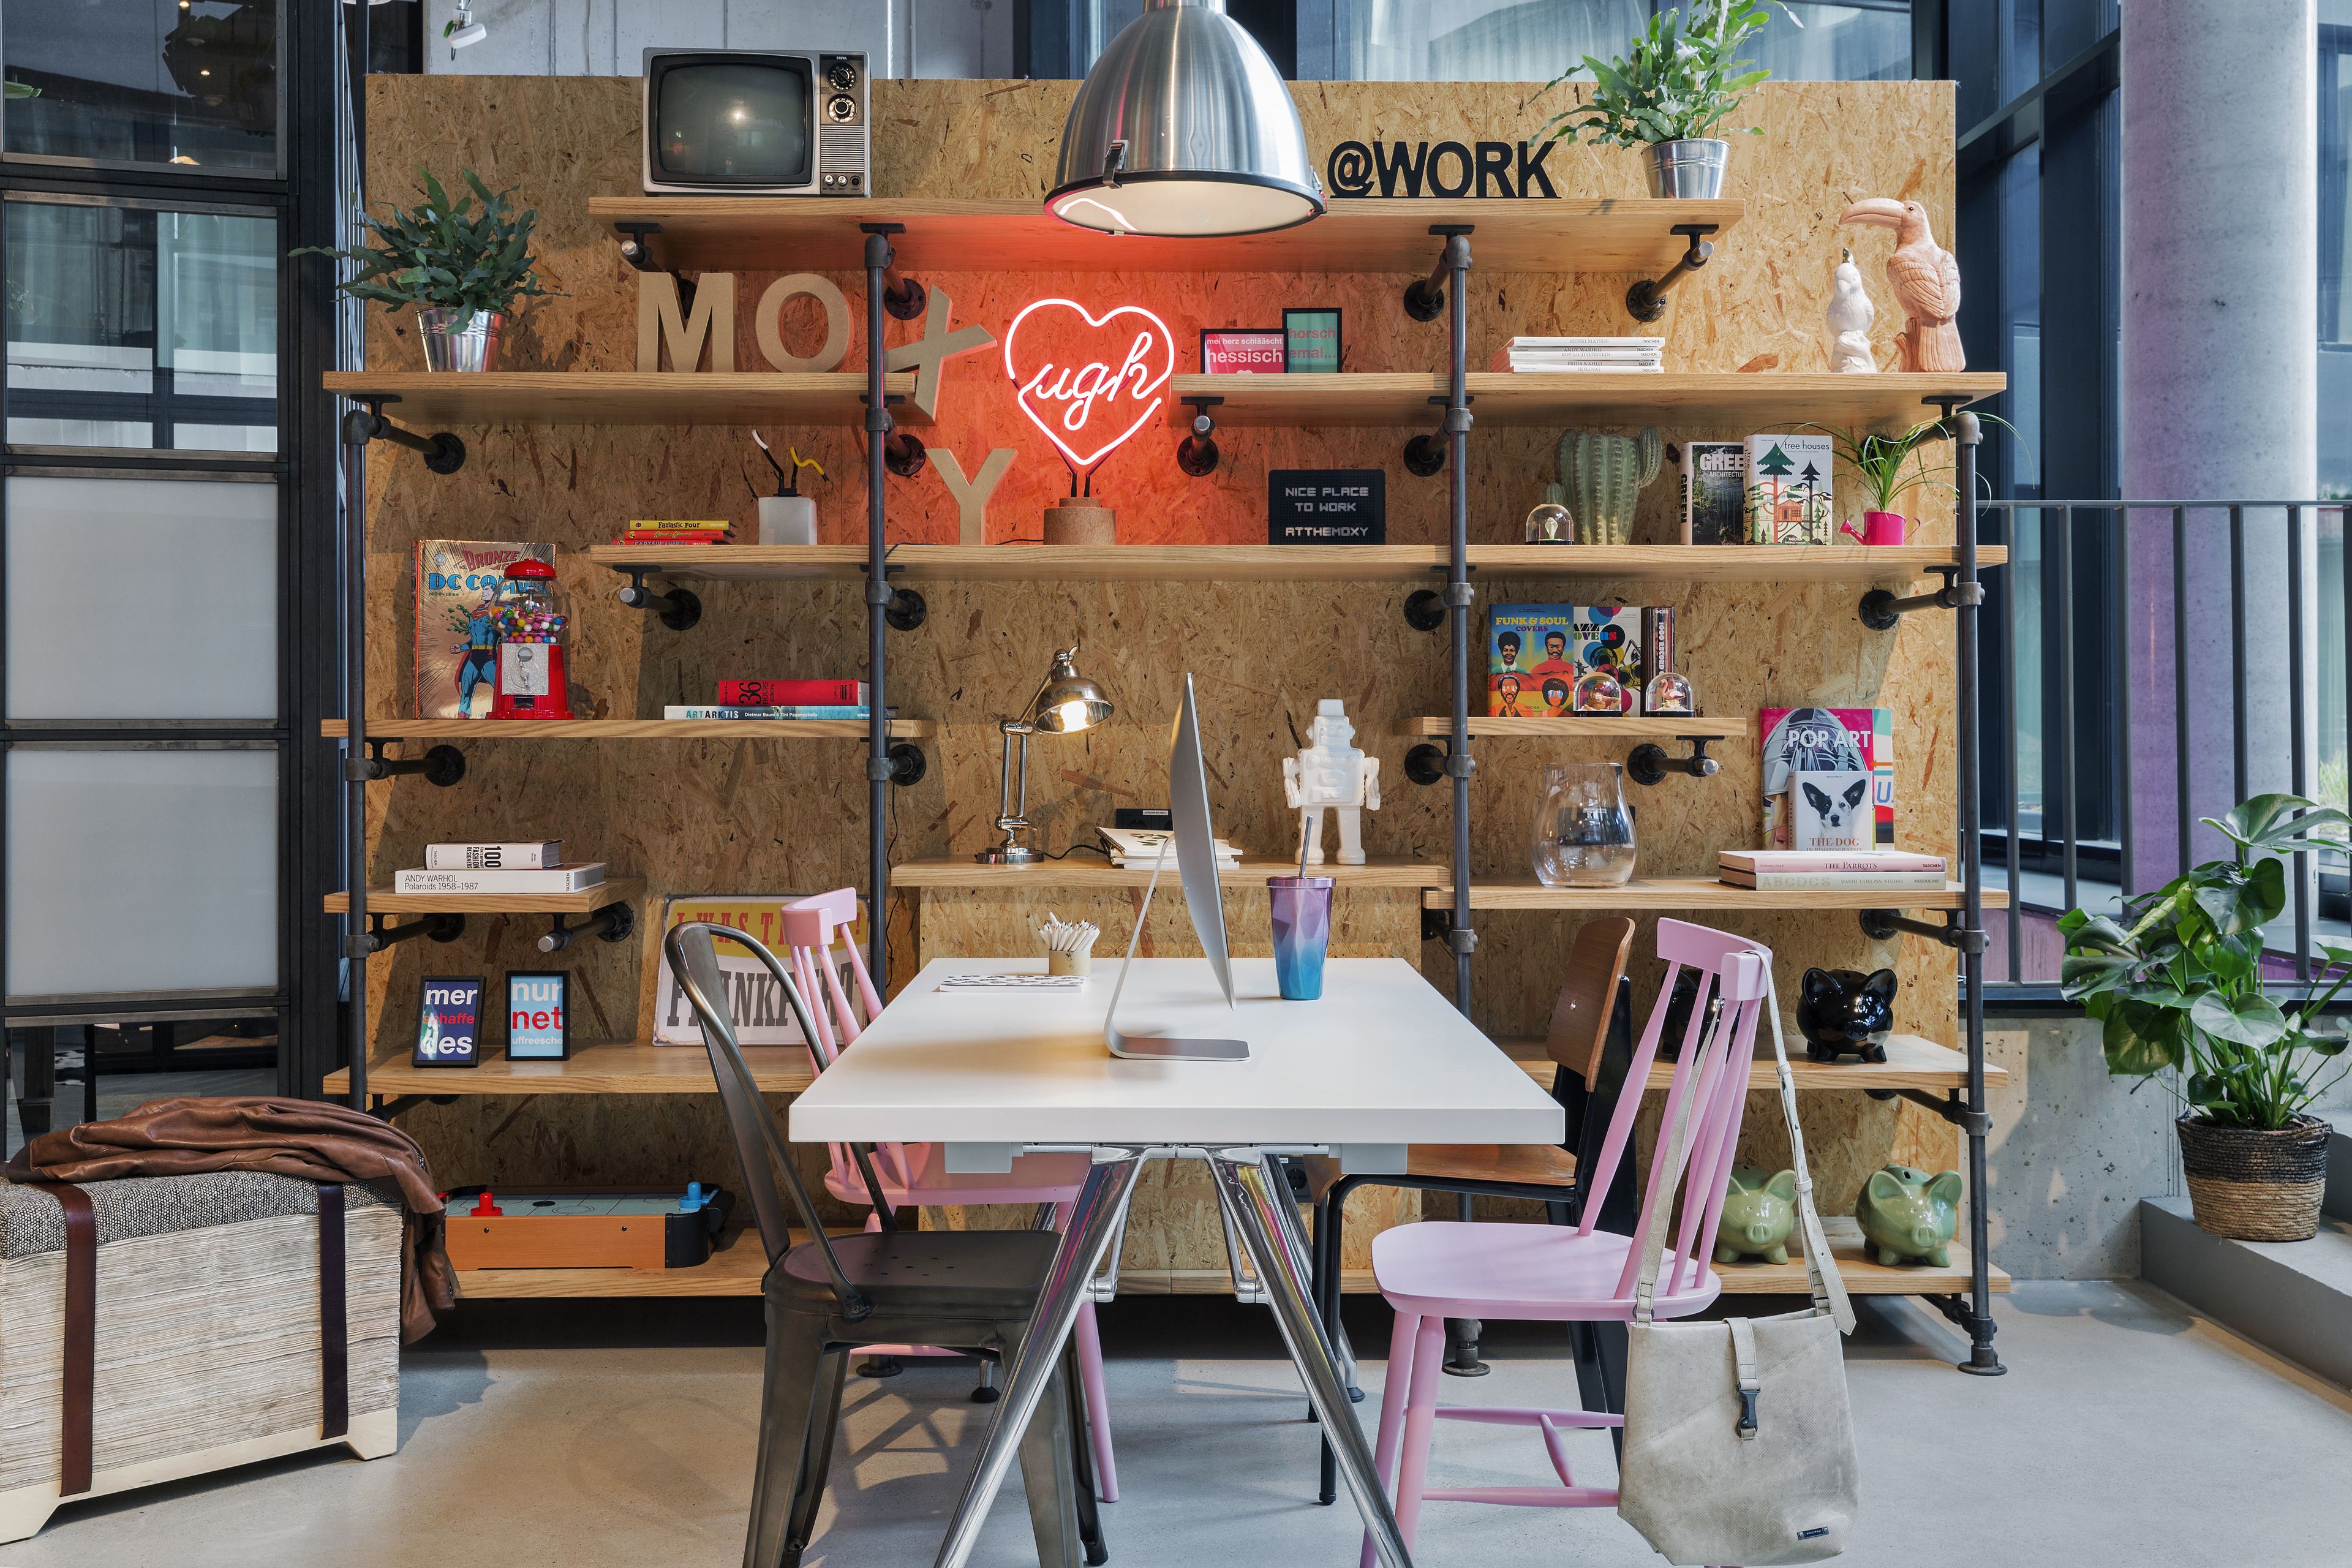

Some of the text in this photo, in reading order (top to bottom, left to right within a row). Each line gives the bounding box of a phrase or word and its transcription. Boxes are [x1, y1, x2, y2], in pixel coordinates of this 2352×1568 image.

[1327, 140, 1559, 198] @WORK
[1289, 326, 1336, 339] horsch
[1207, 349, 1283, 363] hessisch
[1035, 331, 1148, 431] ugh
[1784, 439, 1830, 450] tree houses
[1700, 453, 1744, 471] GREE
[1285, 487, 1369, 497] NICE PLACE
[1294, 502, 1357, 512] TO WORK
[1285, 527, 1369, 537] ATTHEMOXY
[463, 551, 520, 571] BRONZE
[490, 562, 510, 571] AG
[429, 573, 462, 590] DC
[1495, 617, 1569, 625] FUNK & SOUL
[1574, 631, 1617, 641] OVERS
[739, 682, 762, 704] 36
[1789, 730, 1871, 748] POP ART
[1809, 837, 1860, 846] THE DOG
[484, 846, 502, 868] 100
[1843, 862, 1877, 870] PARROTS
[425, 988, 478, 1005] mer
[511, 982, 563, 1002] nur
[422, 1012, 475, 1025] schaffe
[511, 1006, 563, 1030] net
[420, 1036, 473, 1055] des
[512, 1036, 563, 1045] uffreesche
